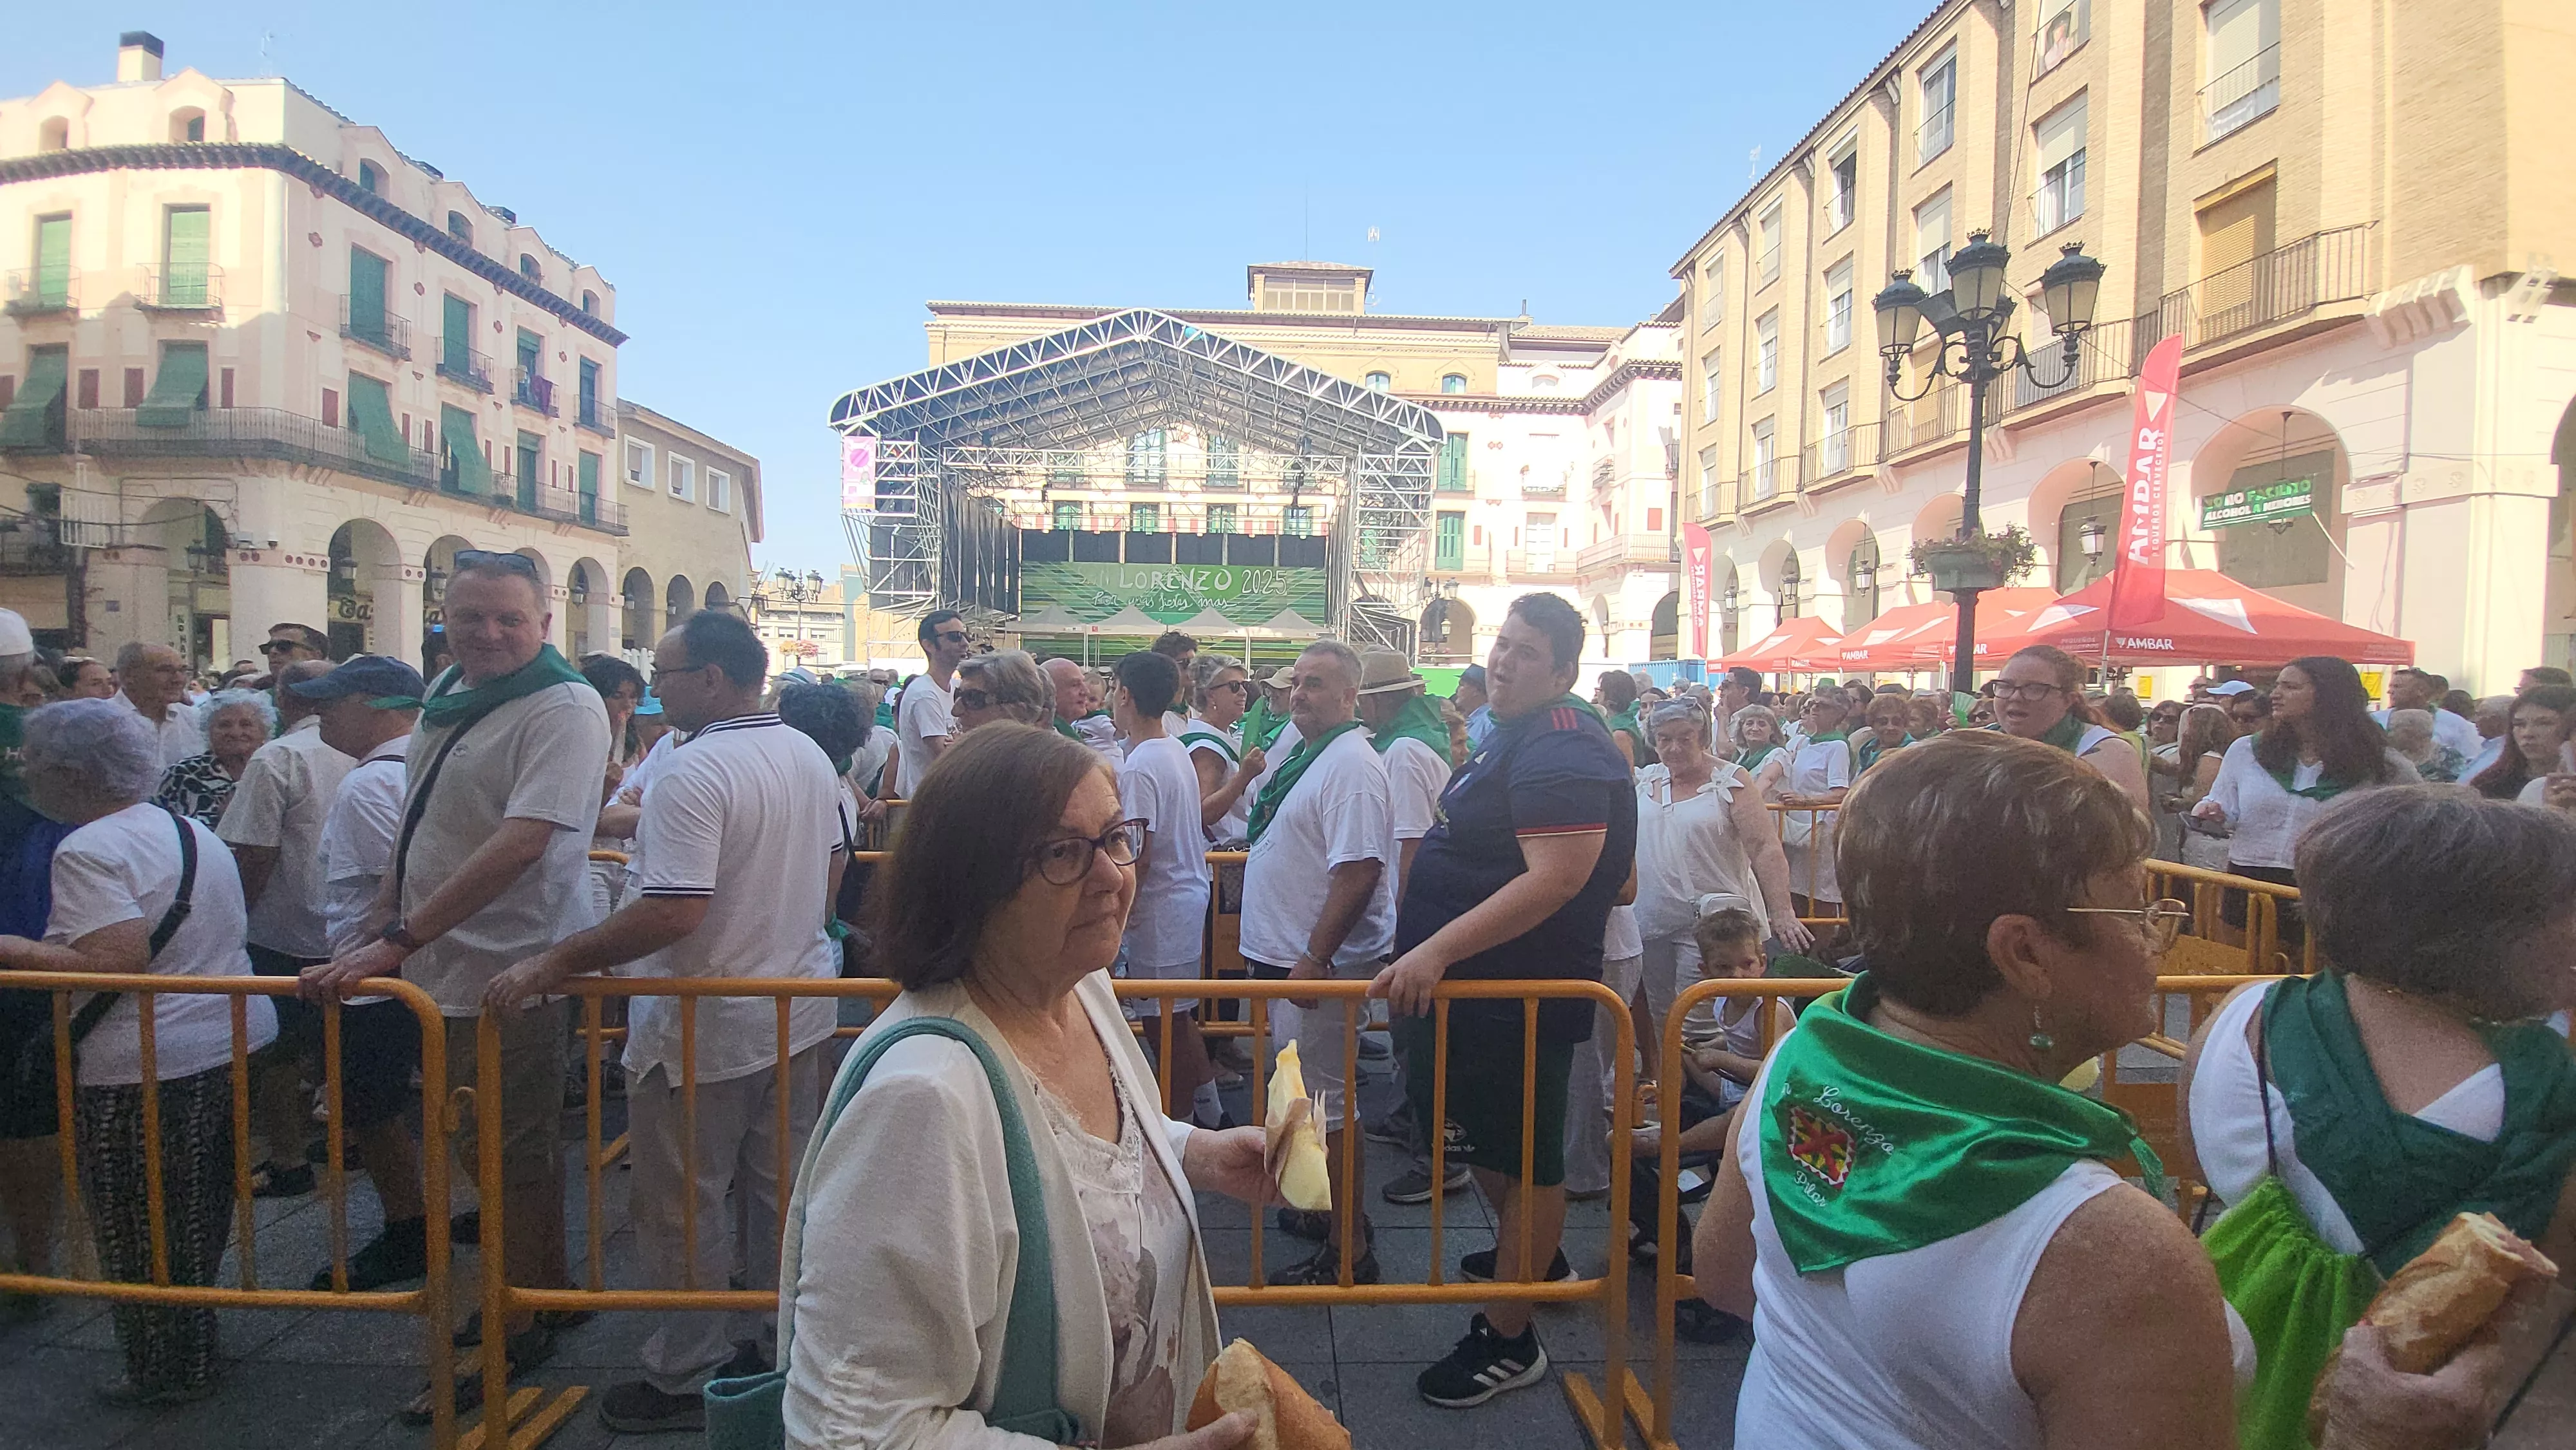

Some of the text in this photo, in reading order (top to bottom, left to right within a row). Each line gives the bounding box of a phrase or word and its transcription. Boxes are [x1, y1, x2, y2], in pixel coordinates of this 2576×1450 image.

[2224, 491, 2245, 507] NO
[2204, 505, 2252, 522] ALCOHOL
[1119, 567, 1233, 592] LORENZO
[1241, 569, 1287, 596] 2025
[2126, 637, 2175, 650] AMBAR
[1846, 650, 1869, 661] AMBAR
[1813, 1085, 1895, 1156] Lorenzo
[1794, 1170, 1826, 1207] Pilar
